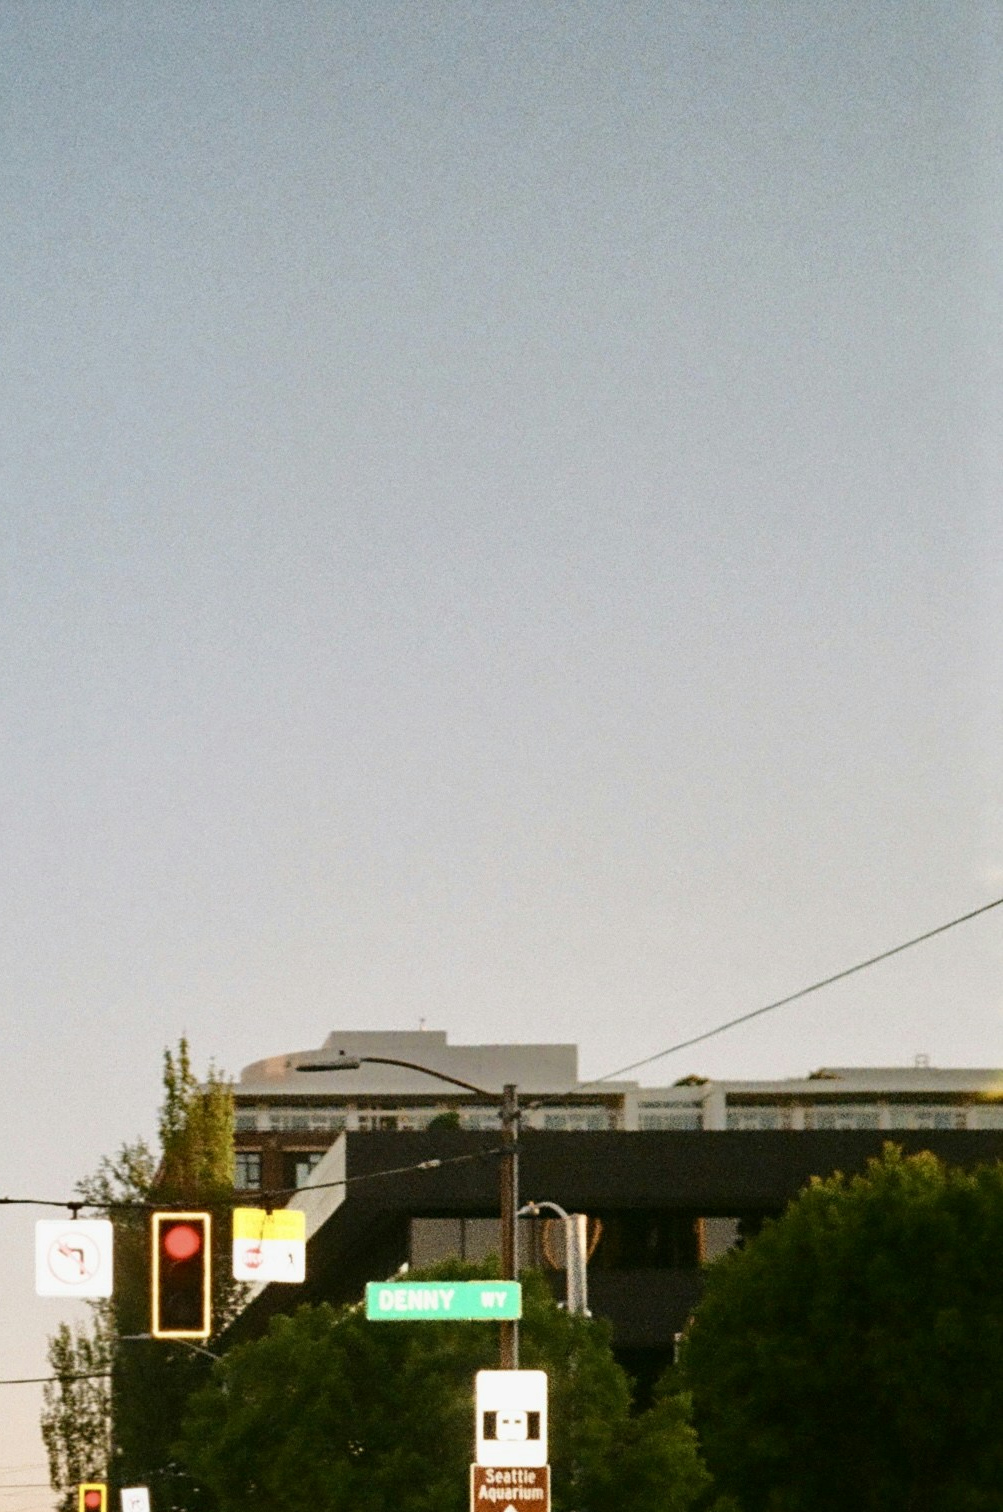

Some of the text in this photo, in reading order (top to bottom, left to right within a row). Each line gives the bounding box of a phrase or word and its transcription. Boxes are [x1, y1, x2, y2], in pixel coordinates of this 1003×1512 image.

[378, 1290, 507, 1311] DENNY WY
[486, 1468, 537, 1484] Seattle
[479, 1486, 544, 1503] Aquarium
